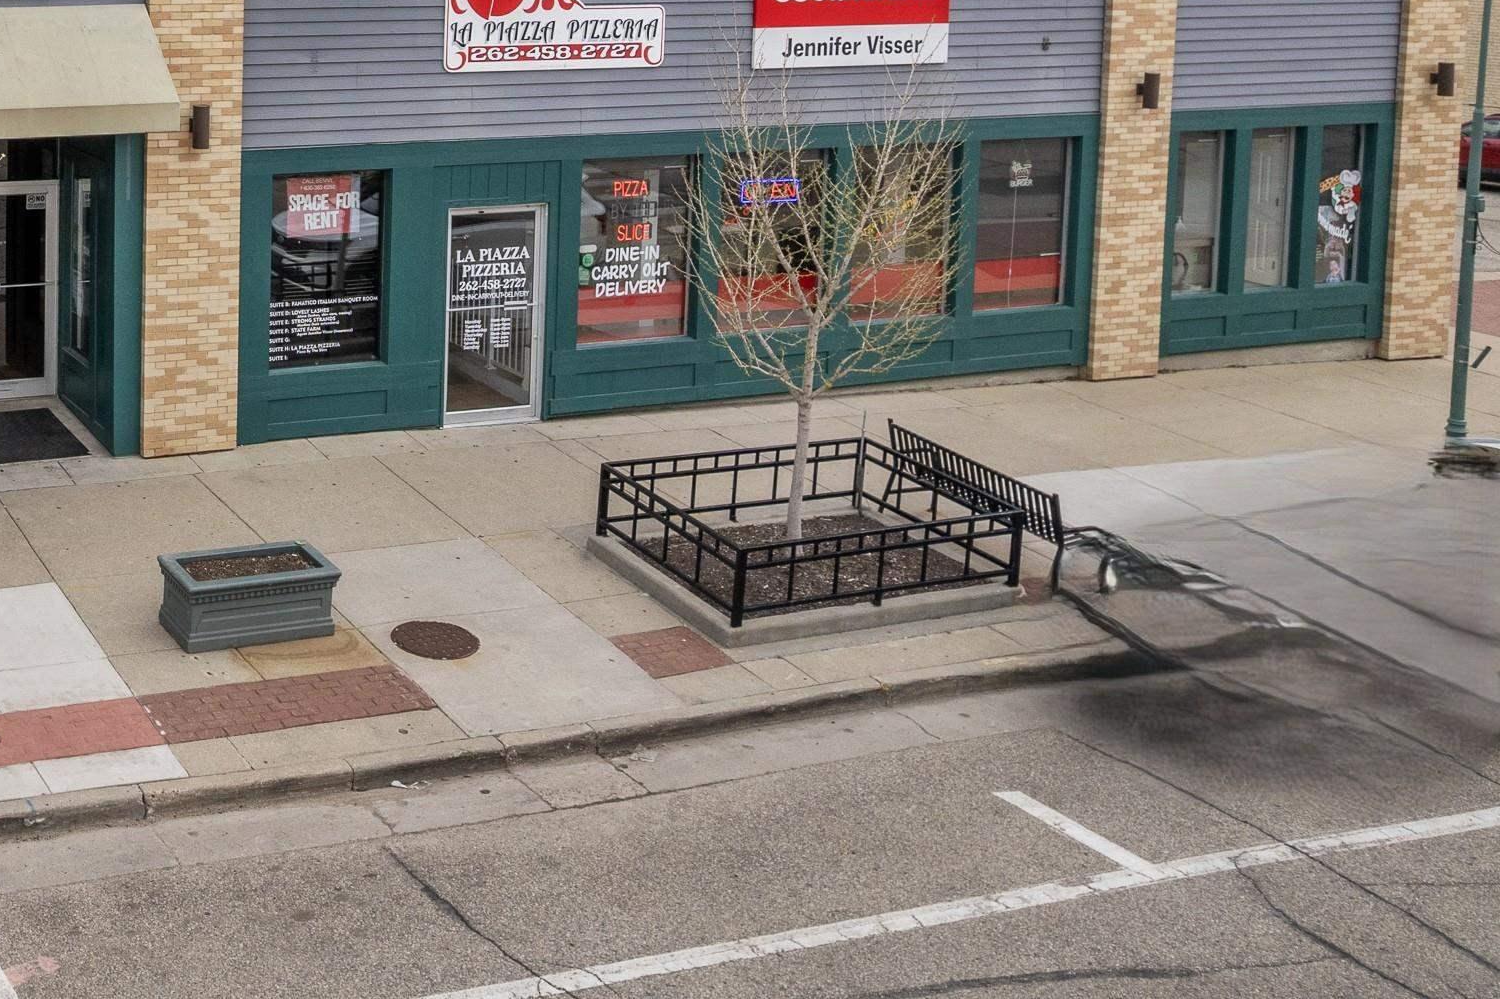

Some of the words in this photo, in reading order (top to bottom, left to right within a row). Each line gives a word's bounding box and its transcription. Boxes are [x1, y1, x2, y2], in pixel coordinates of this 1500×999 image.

[450, 21, 473, 48] LA
[484, 19, 556, 42] PIAZZA
[567, 18, 659, 41] PIZZERIA
[782, 36, 861, 58] Jennifer
[867, 35, 923, 55] Visser
[613, 180, 649, 197] PIZZA
[288, 193, 329, 212] SPACE
[335, 191, 360, 209] FOR
[304, 210, 340, 230] RENT
[616, 223, 650, 242] SLICE
[456, 249, 476, 263] LA
[479, 246, 531, 261] PIAZZA
[604, 244, 660, 263] DINE-IN
[461, 261, 526, 278] PIZZERIA
[591, 263, 639, 281] CARRY
[642, 261, 671, 278] OUT
[459, 277, 527, 292] 262-458-2727
[595, 278, 667, 298] DELIVERY
